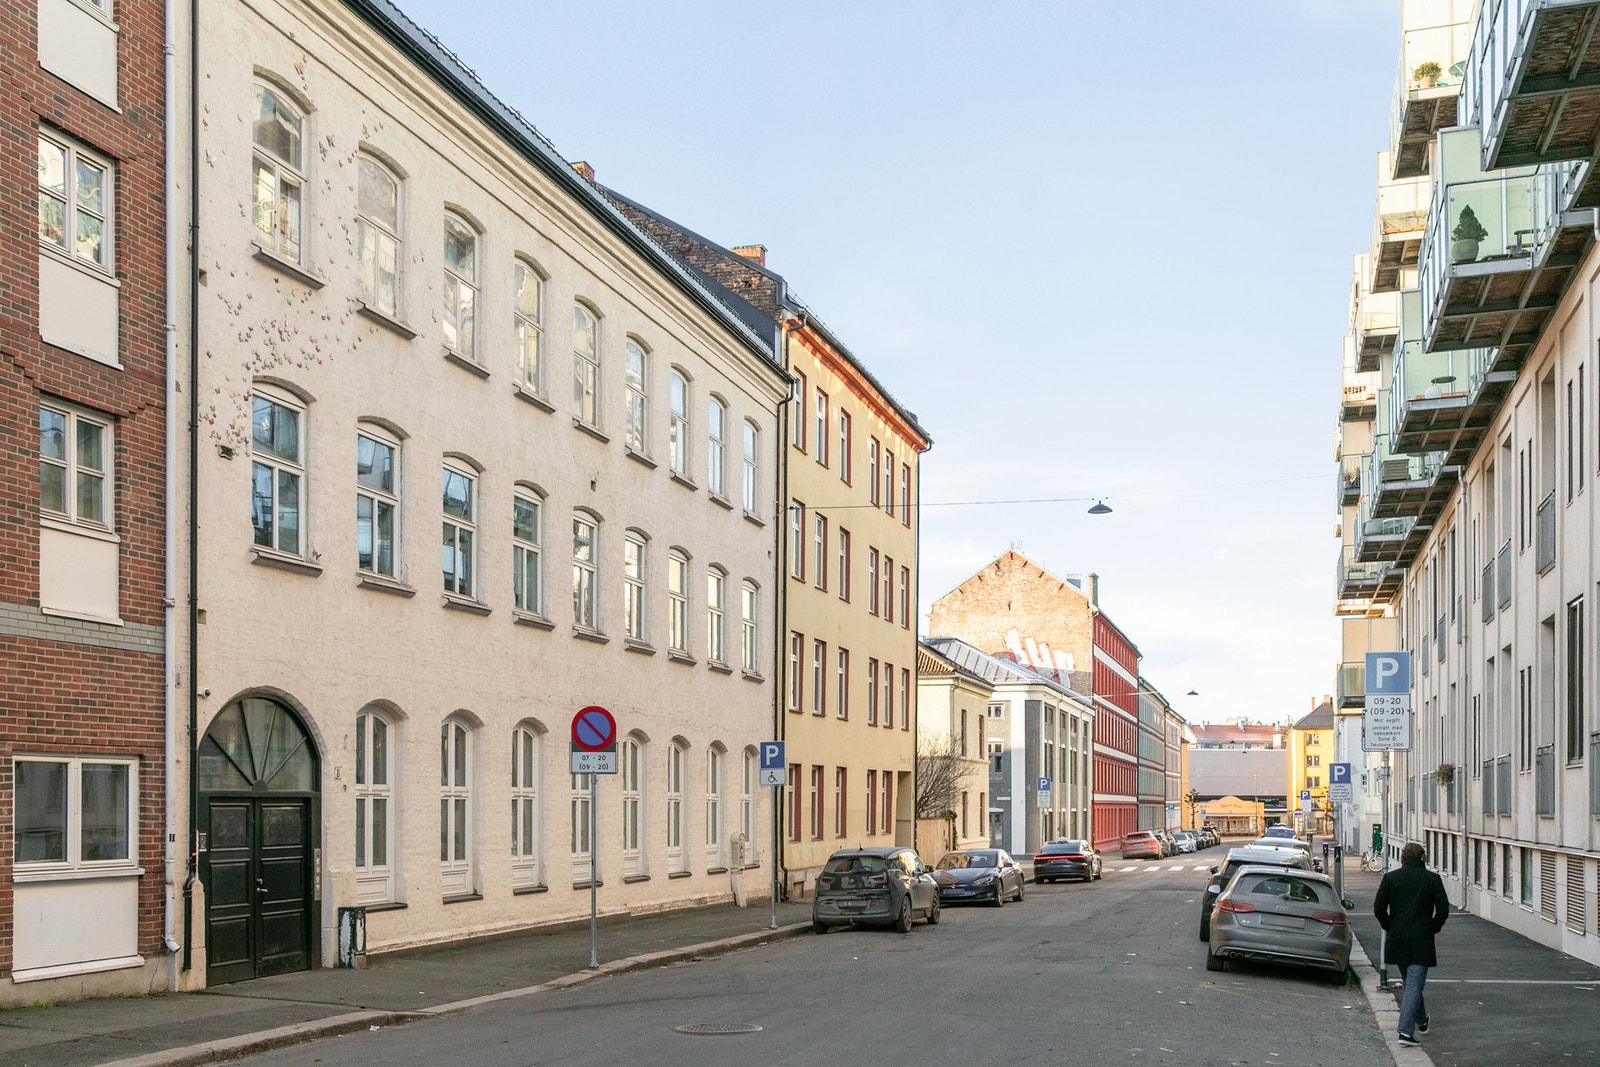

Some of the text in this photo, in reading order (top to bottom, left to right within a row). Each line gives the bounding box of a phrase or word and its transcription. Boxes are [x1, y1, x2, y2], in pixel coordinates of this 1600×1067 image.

[1376, 658, 1399, 688] P
[766, 744, 779, 765] P
[1334, 766, 1346, 781] P
[1040, 779, 1048, 789] P
